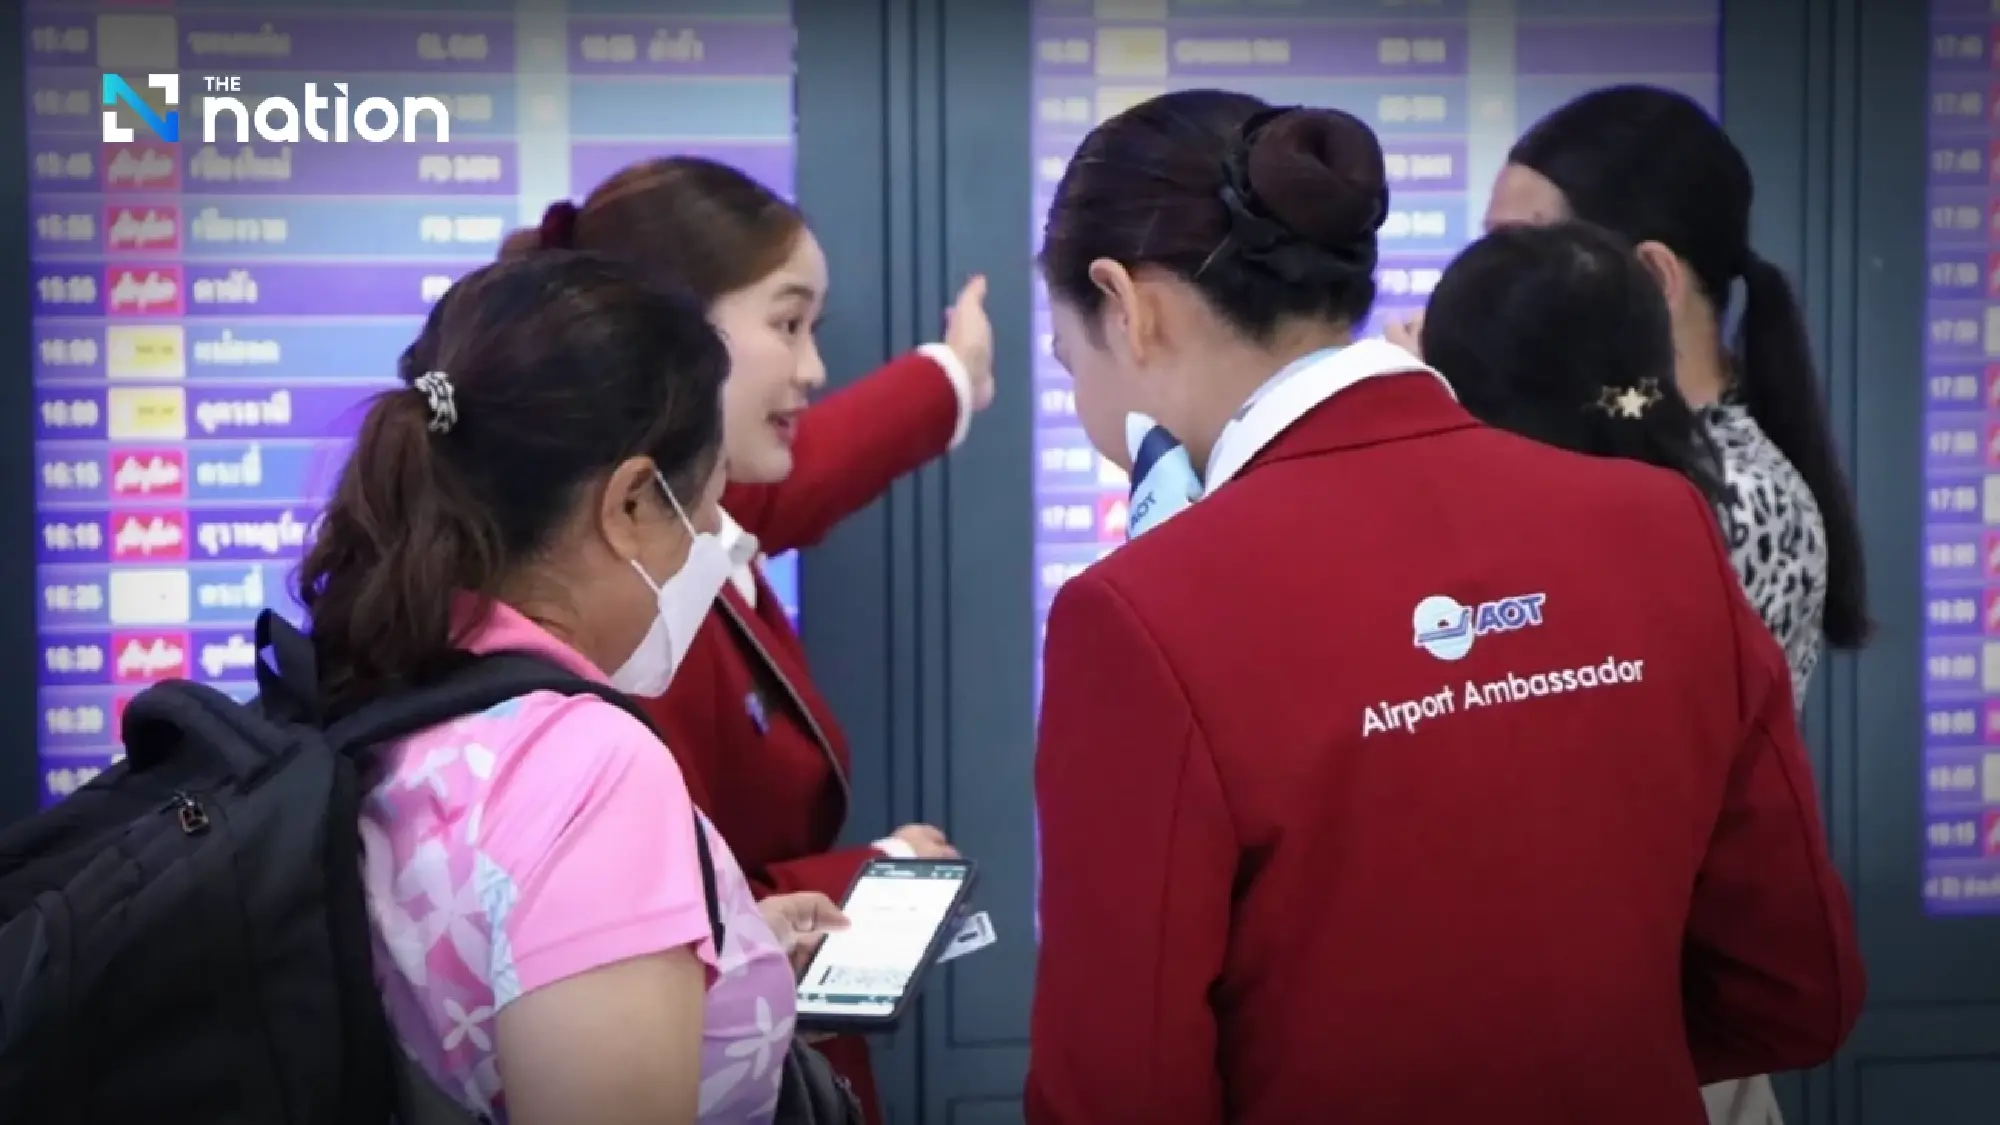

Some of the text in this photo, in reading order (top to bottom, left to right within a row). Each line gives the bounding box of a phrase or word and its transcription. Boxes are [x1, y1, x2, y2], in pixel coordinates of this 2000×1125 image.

[1475, 593, 1546, 635] AOT
[1362, 656, 1644, 738] Airport Ambassador
